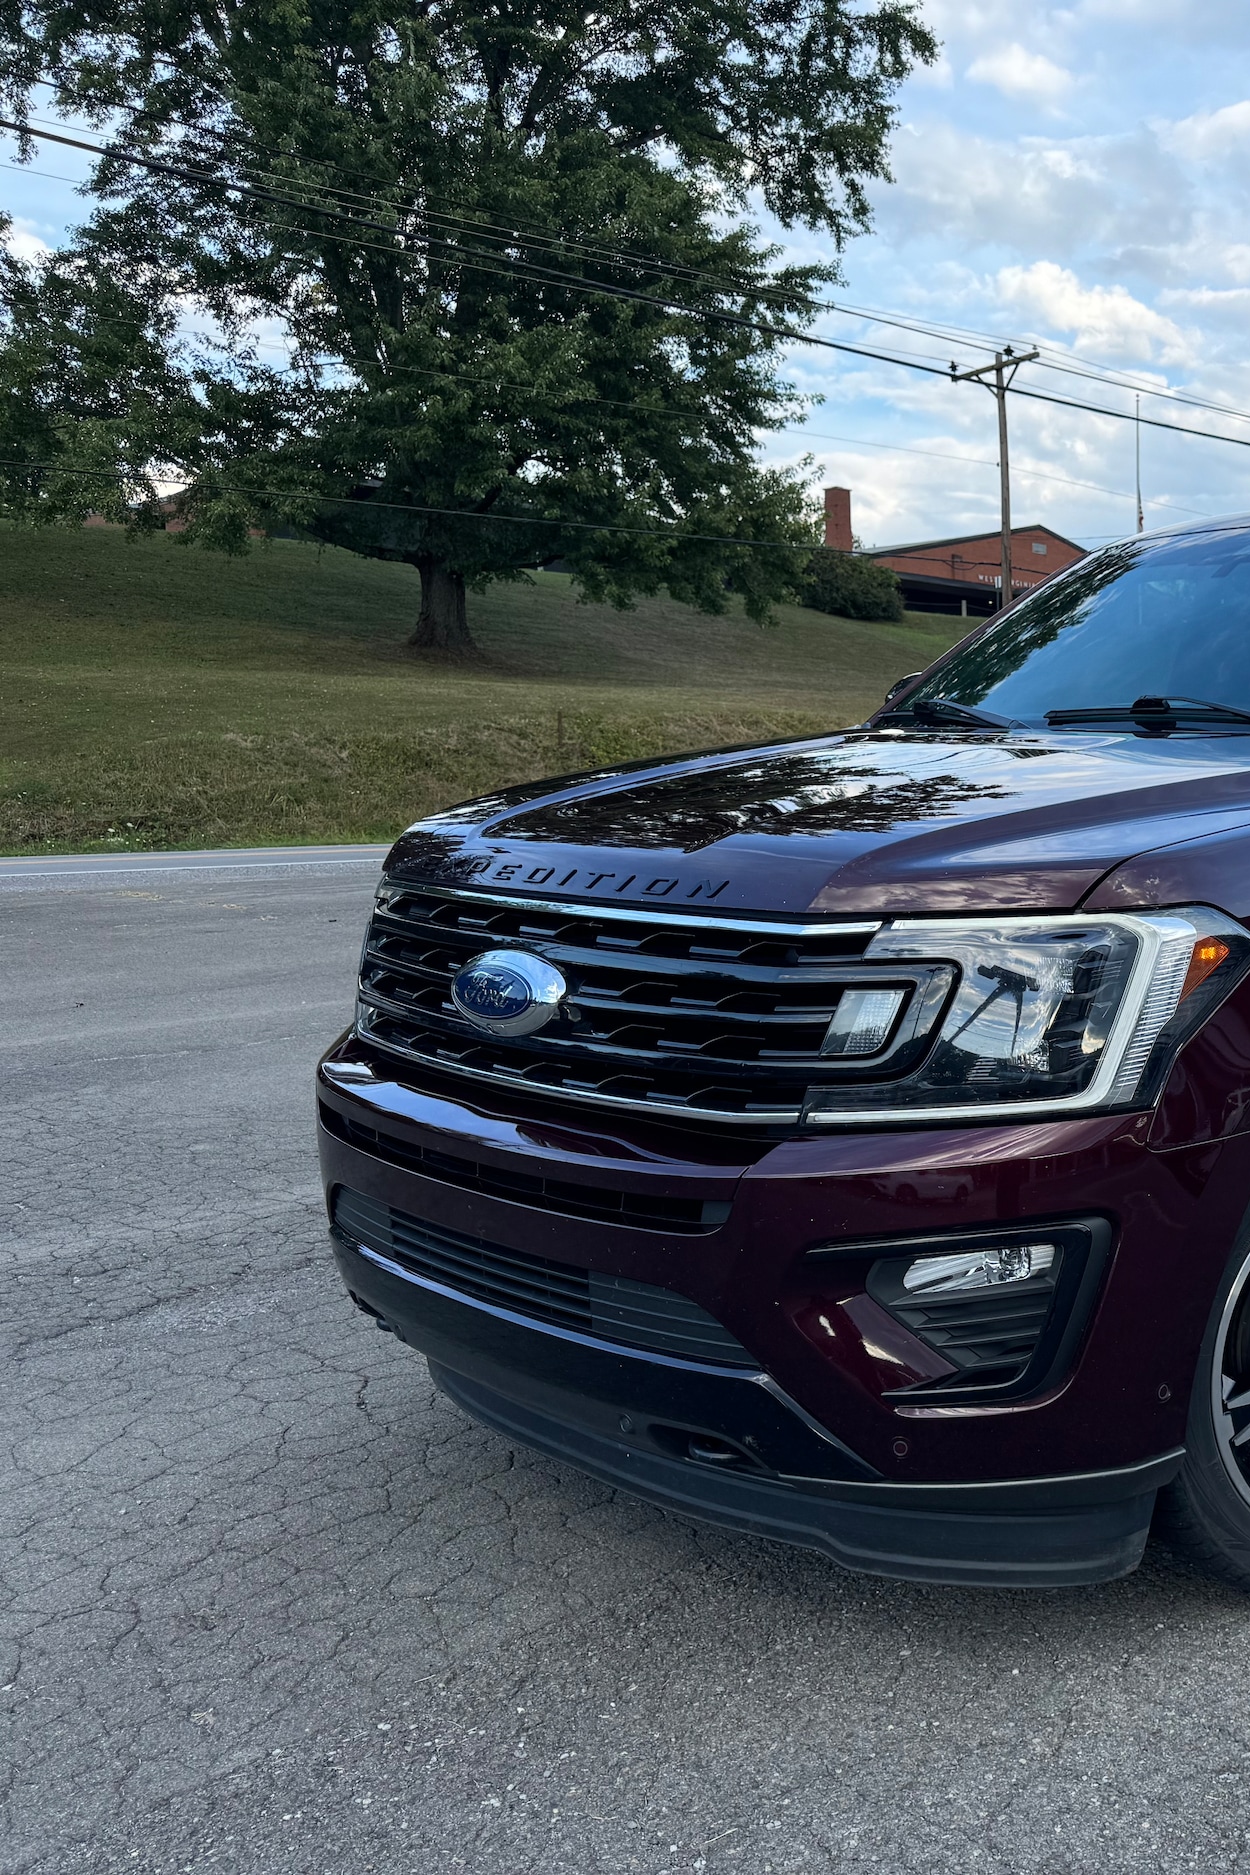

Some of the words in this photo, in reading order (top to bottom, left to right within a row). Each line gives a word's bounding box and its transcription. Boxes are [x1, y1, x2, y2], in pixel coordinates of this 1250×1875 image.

[978, 574, 996, 583] WES
[432, 853, 730, 899] PEDITION
[464, 971, 513, 1008] Ford
